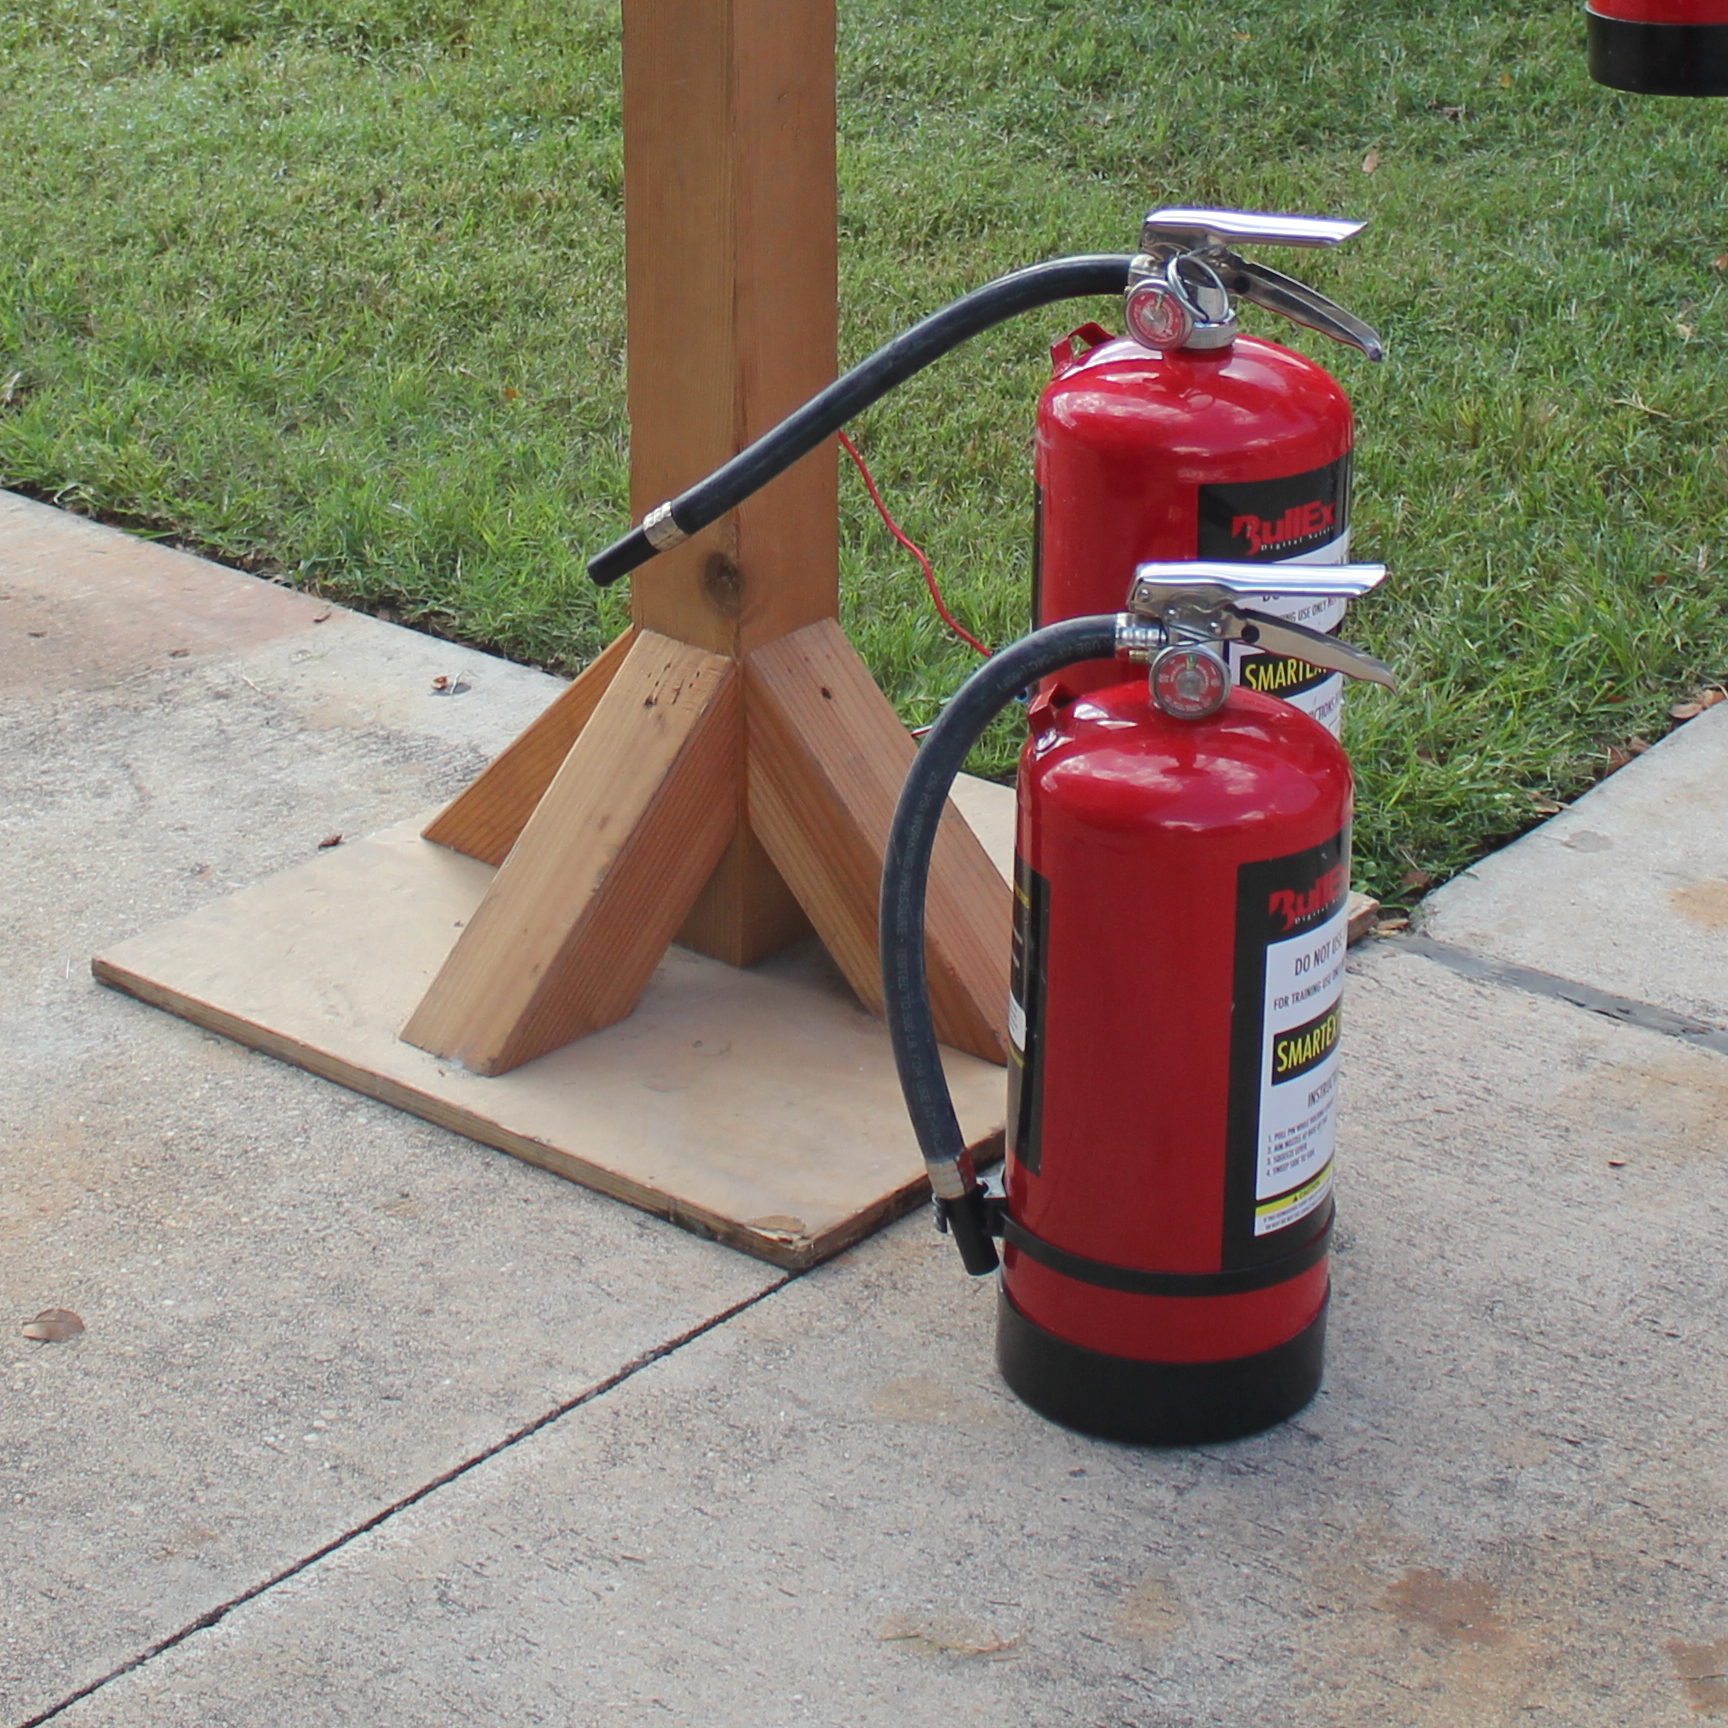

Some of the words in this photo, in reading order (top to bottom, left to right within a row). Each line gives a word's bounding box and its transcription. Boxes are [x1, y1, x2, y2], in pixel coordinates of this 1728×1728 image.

[1231, 500, 1337, 557] BullEx
[1260, 537, 1303, 552] Digital
[1297, 605, 1312, 623] USE
[1312, 598, 1328, 616] ONLY
[1244, 658, 1328, 693] SMARTE
[896, 872, 911, 936] PRESSURE
[1268, 863, 1347, 933] BullE
[896, 947, 910, 992] TESTED
[1294, 953, 1312, 977] DO
[1313, 941, 1331, 969] NOT
[1273, 996, 1290, 1012] FOR
[1291, 981, 1322, 1005] TRAINING
